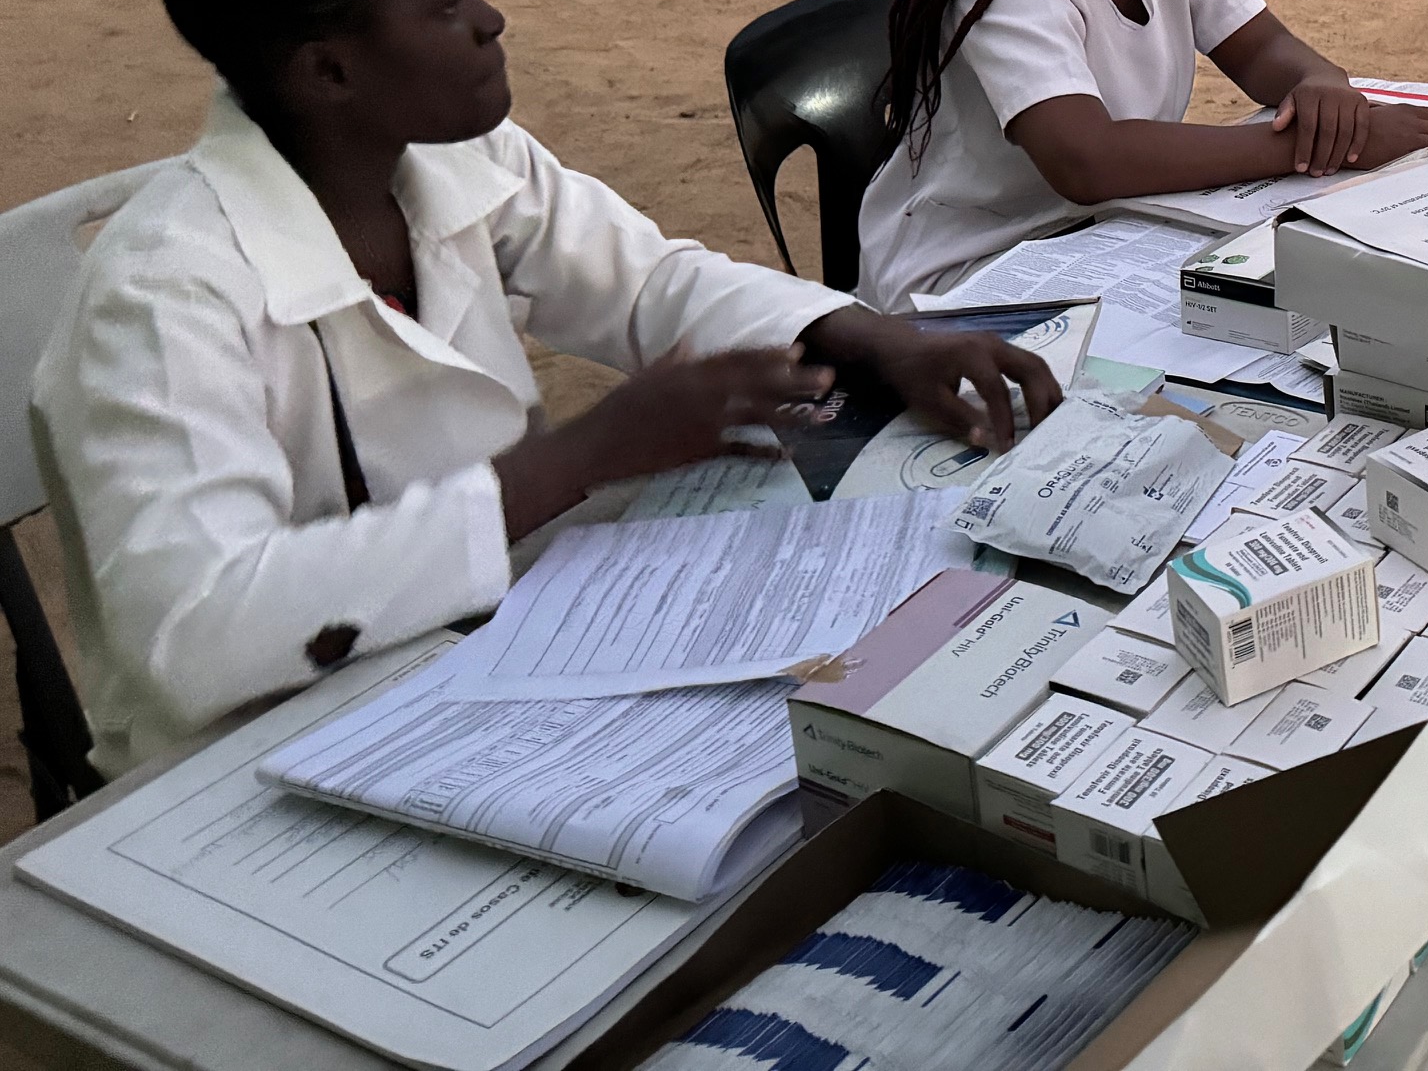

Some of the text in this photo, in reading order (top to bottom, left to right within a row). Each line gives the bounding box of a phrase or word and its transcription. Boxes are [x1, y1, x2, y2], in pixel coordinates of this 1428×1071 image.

[1206, 305, 1217, 313] SET
[1229, 404, 1301, 427] TENTCO
[952, 638, 977, 657] HIV
[980, 628, 1067, 699] Trinity Biotech
[1024, 744, 1054, 769] Tablets
[1045, 751, 1063, 764] and
[1075, 737, 1144, 801] Tenofovir Disoproxil
[1097, 751, 1144, 795] Fumarate and
[1100, 746, 1164, 807] Lamivudine Tablets
[471, 884, 520, 919] Casos
[449, 921, 470, 937] de
[419, 938, 449, 959] ITS
